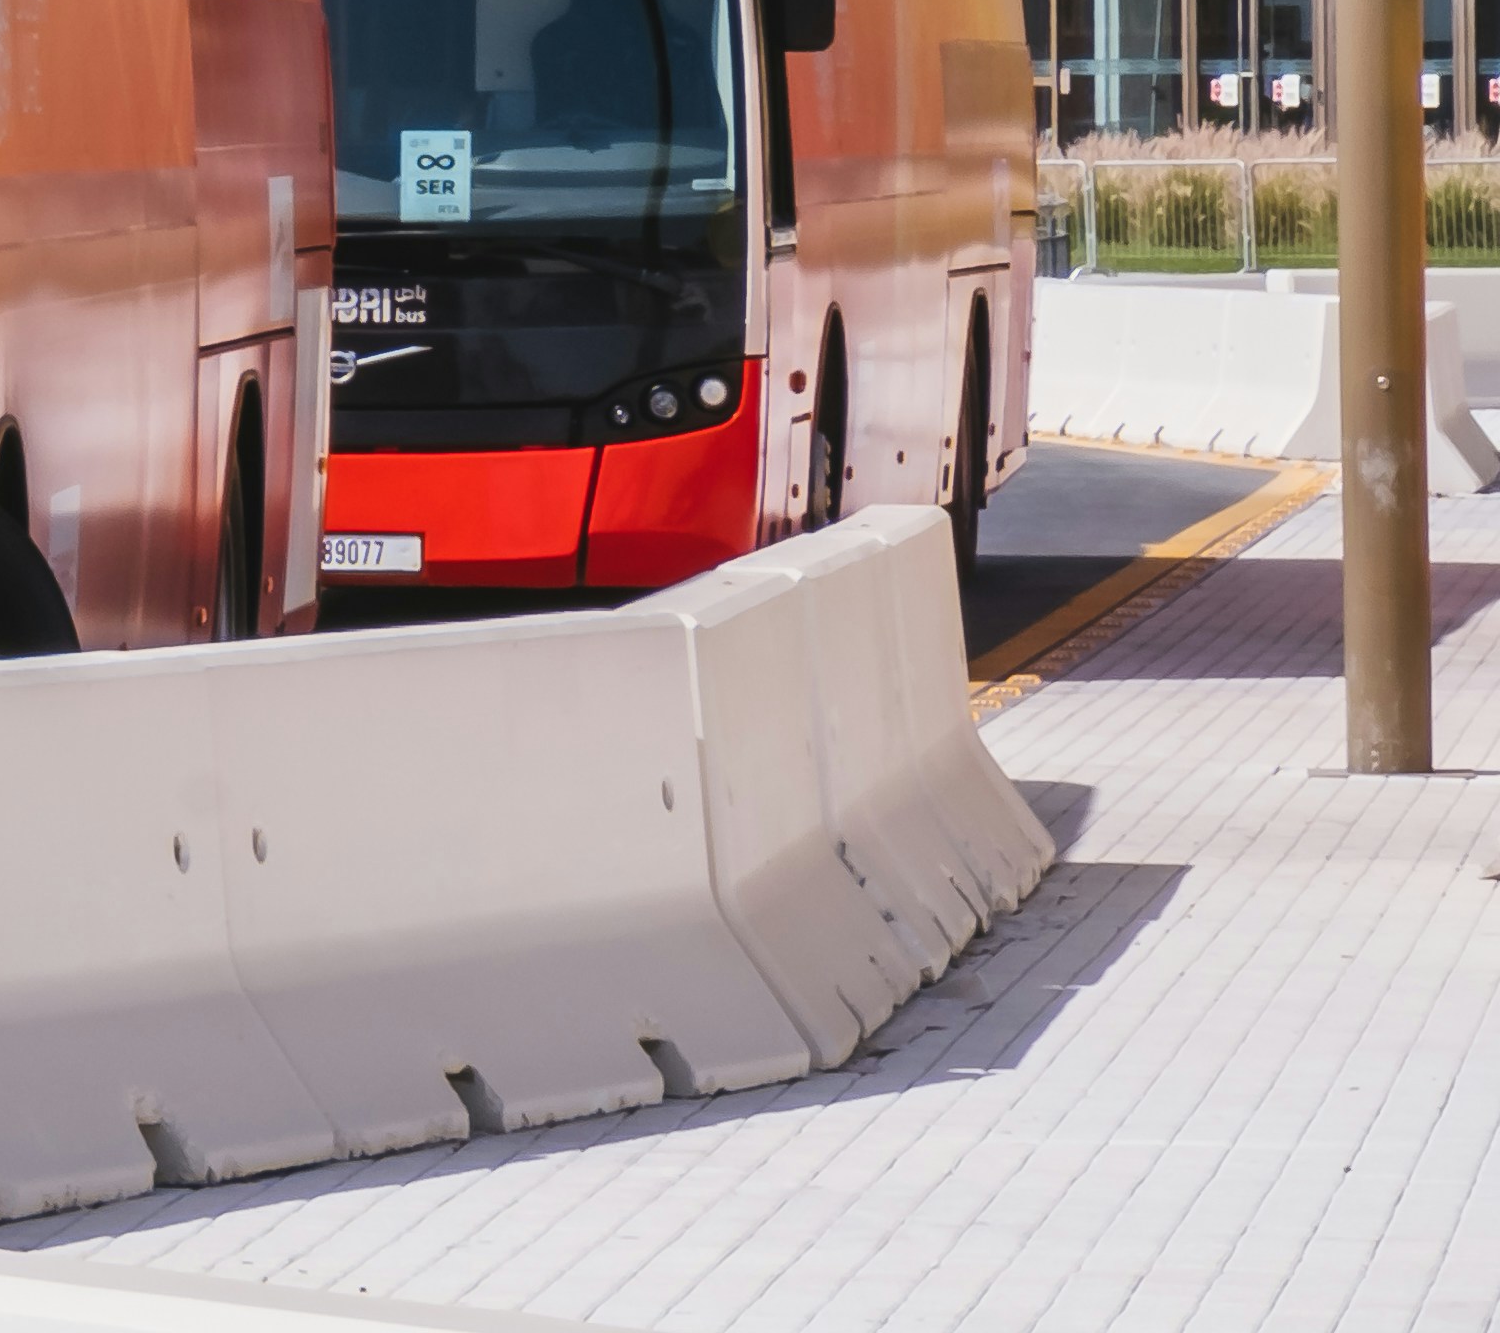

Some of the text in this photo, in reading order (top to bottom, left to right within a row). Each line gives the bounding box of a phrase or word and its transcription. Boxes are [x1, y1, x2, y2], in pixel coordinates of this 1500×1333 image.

[415, 179, 456, 195] SER
[332, 288, 392, 324] BAI
[394, 307, 427, 324] bus
